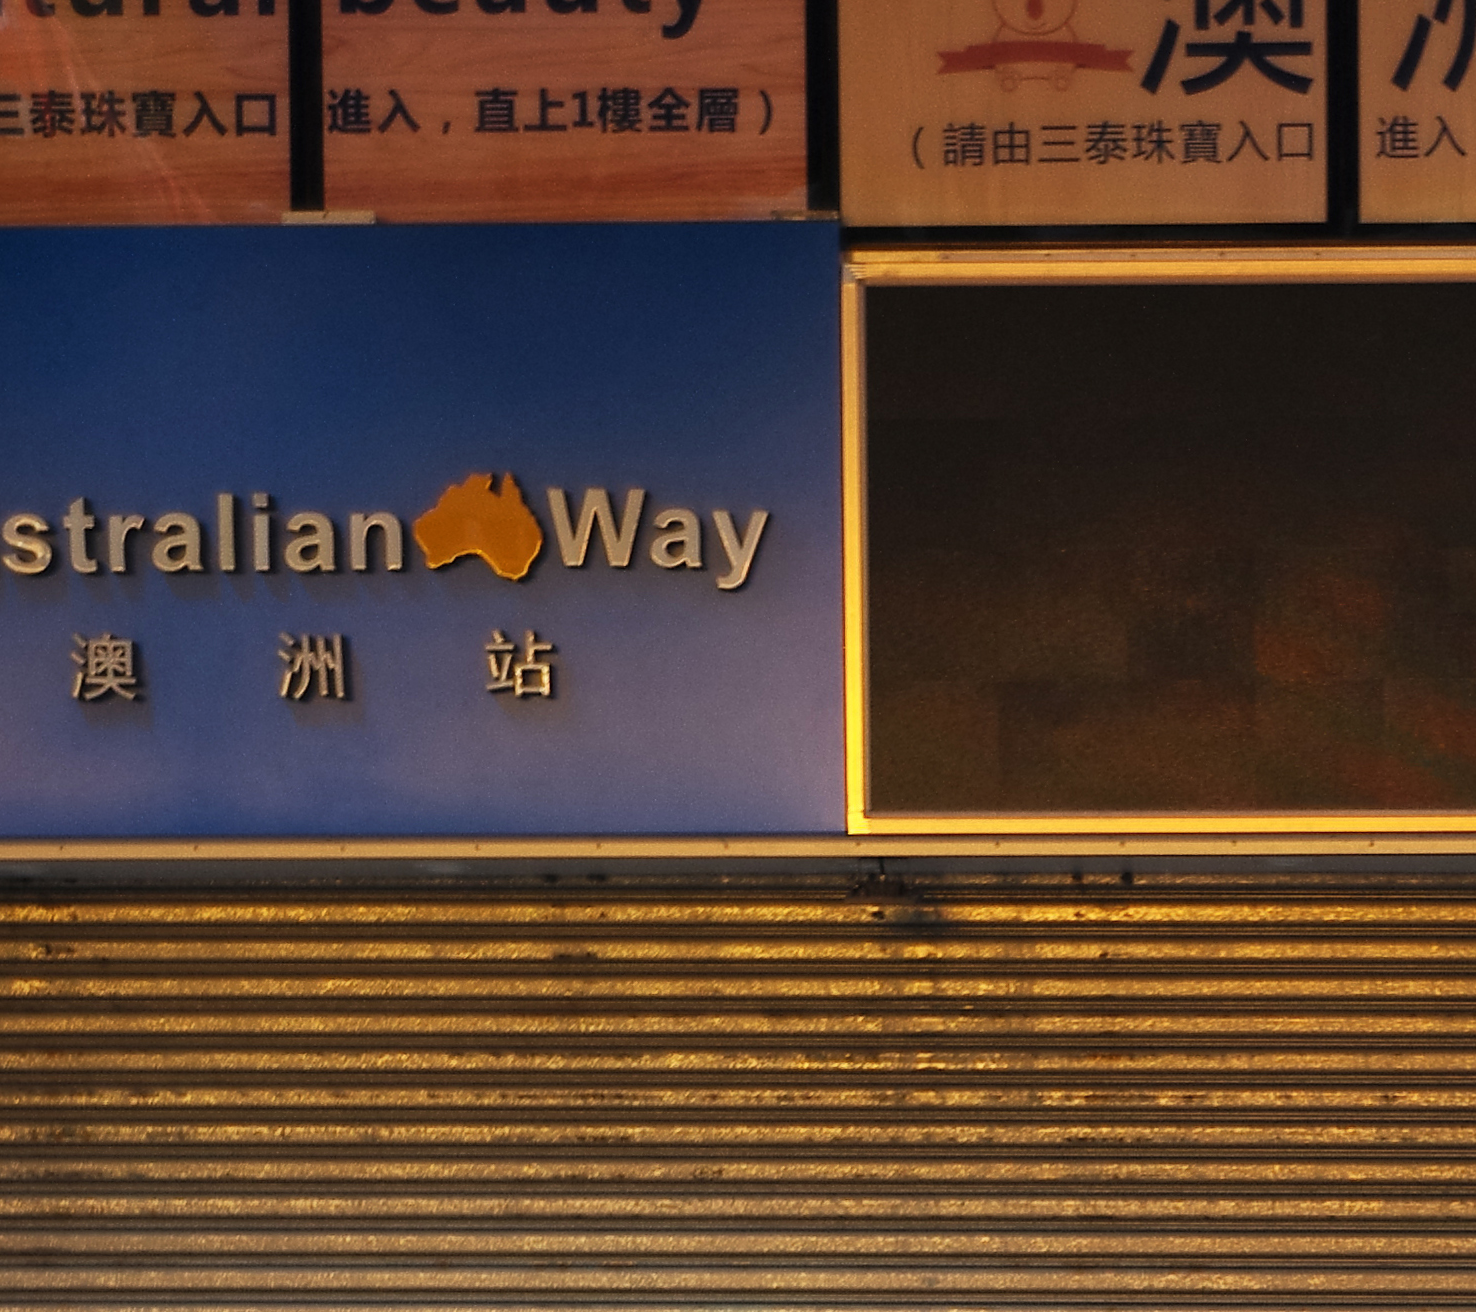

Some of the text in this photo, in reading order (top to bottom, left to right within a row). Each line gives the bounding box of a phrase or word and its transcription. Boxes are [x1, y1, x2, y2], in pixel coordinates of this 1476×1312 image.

[547, 488, 772, 591] Way
[70, 631, 555, 701] 澳洲站
